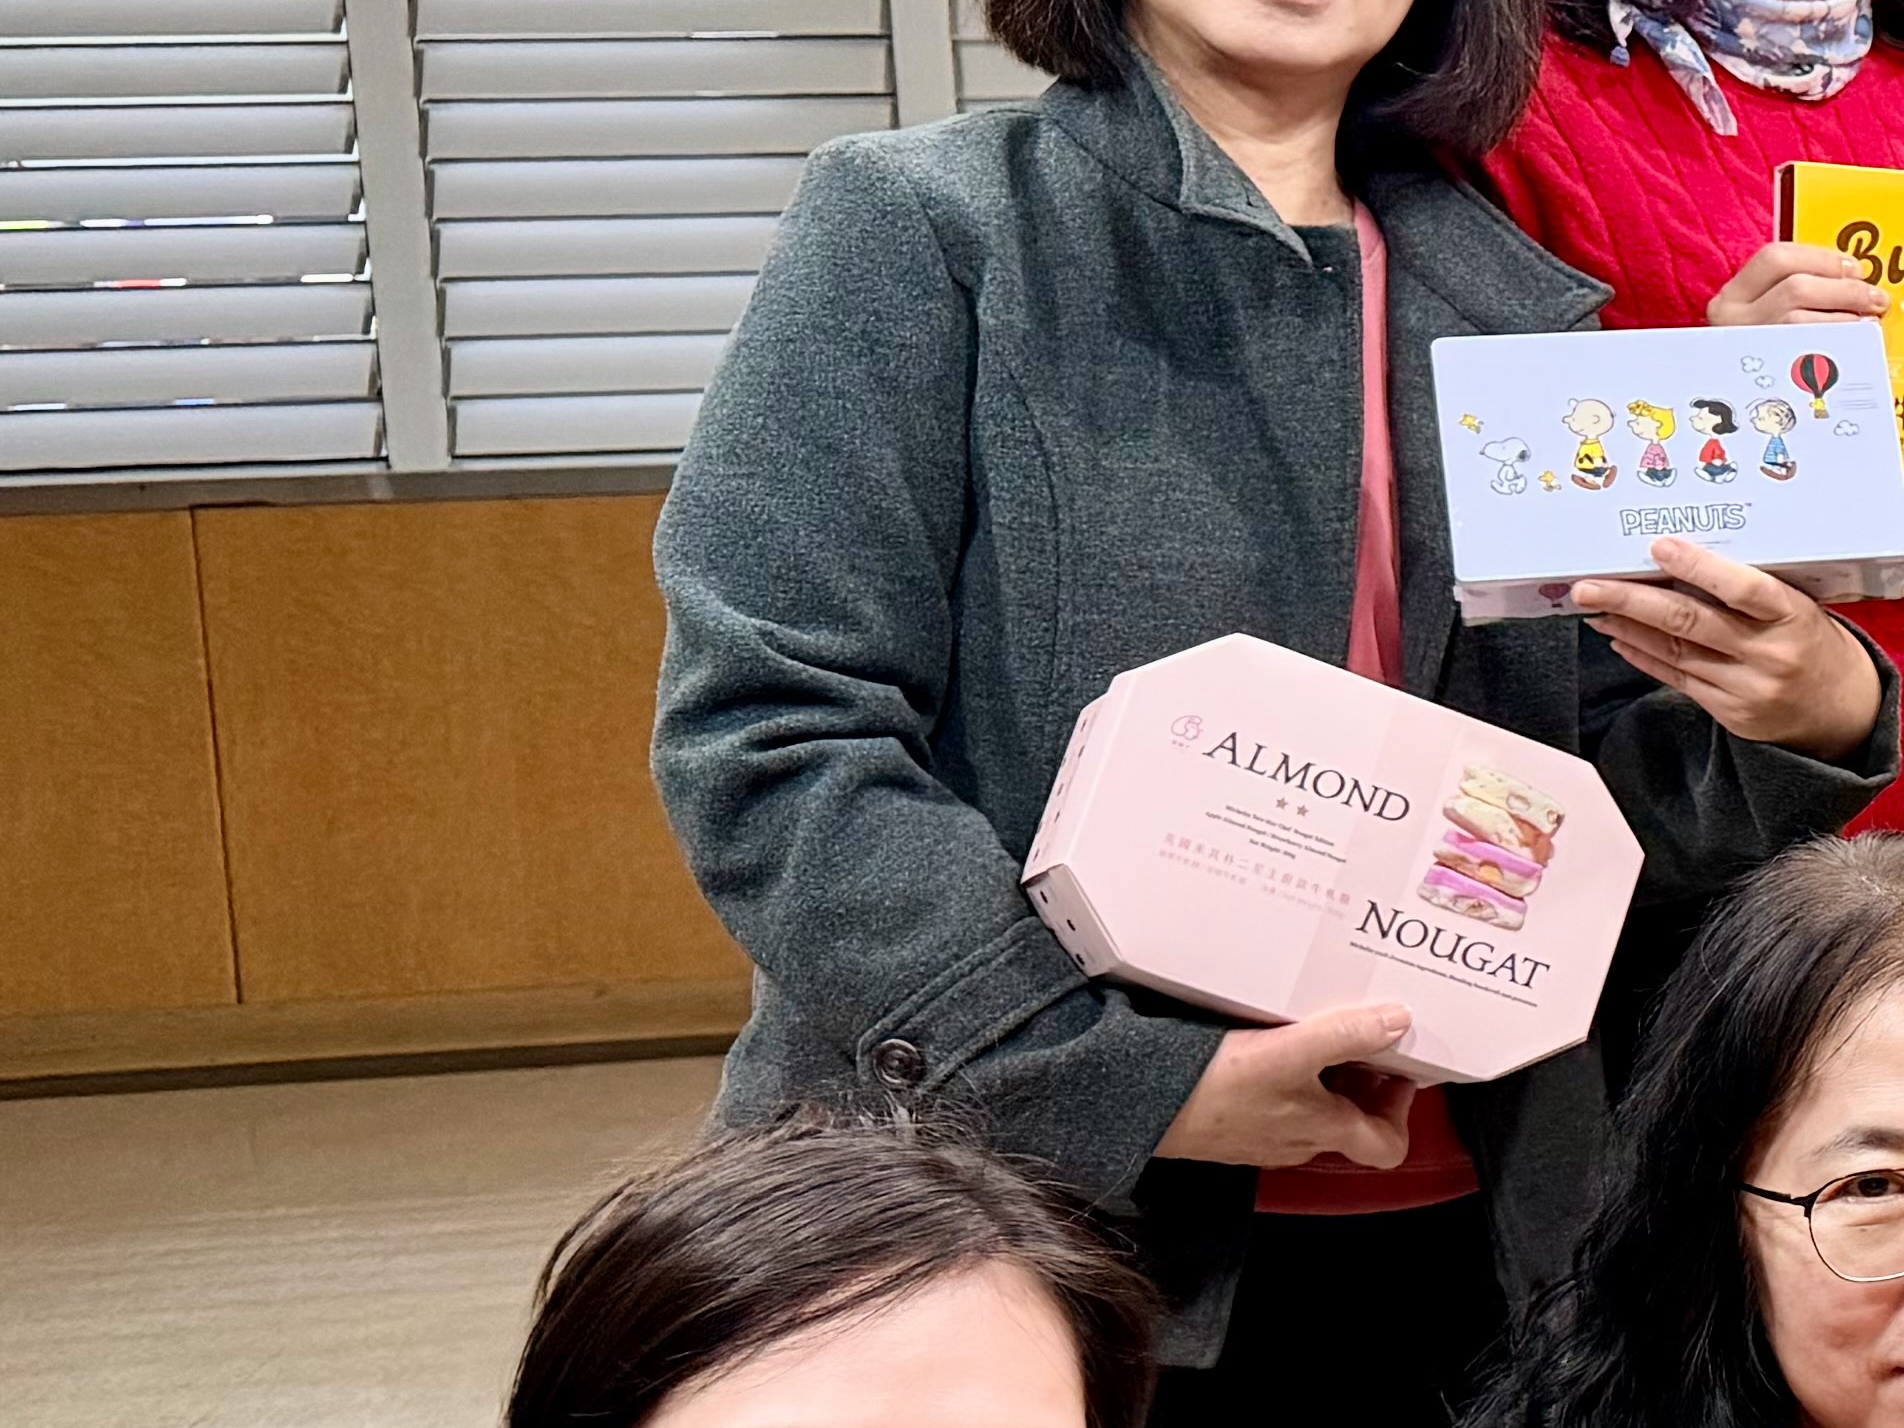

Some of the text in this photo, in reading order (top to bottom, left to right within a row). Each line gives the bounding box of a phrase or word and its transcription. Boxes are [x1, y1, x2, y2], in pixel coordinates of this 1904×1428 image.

[1620, 503, 1746, 535] PEANUTS
[1202, 731, 1411, 823] ALMOND
[1355, 899, 1550, 989] NOUGAT
